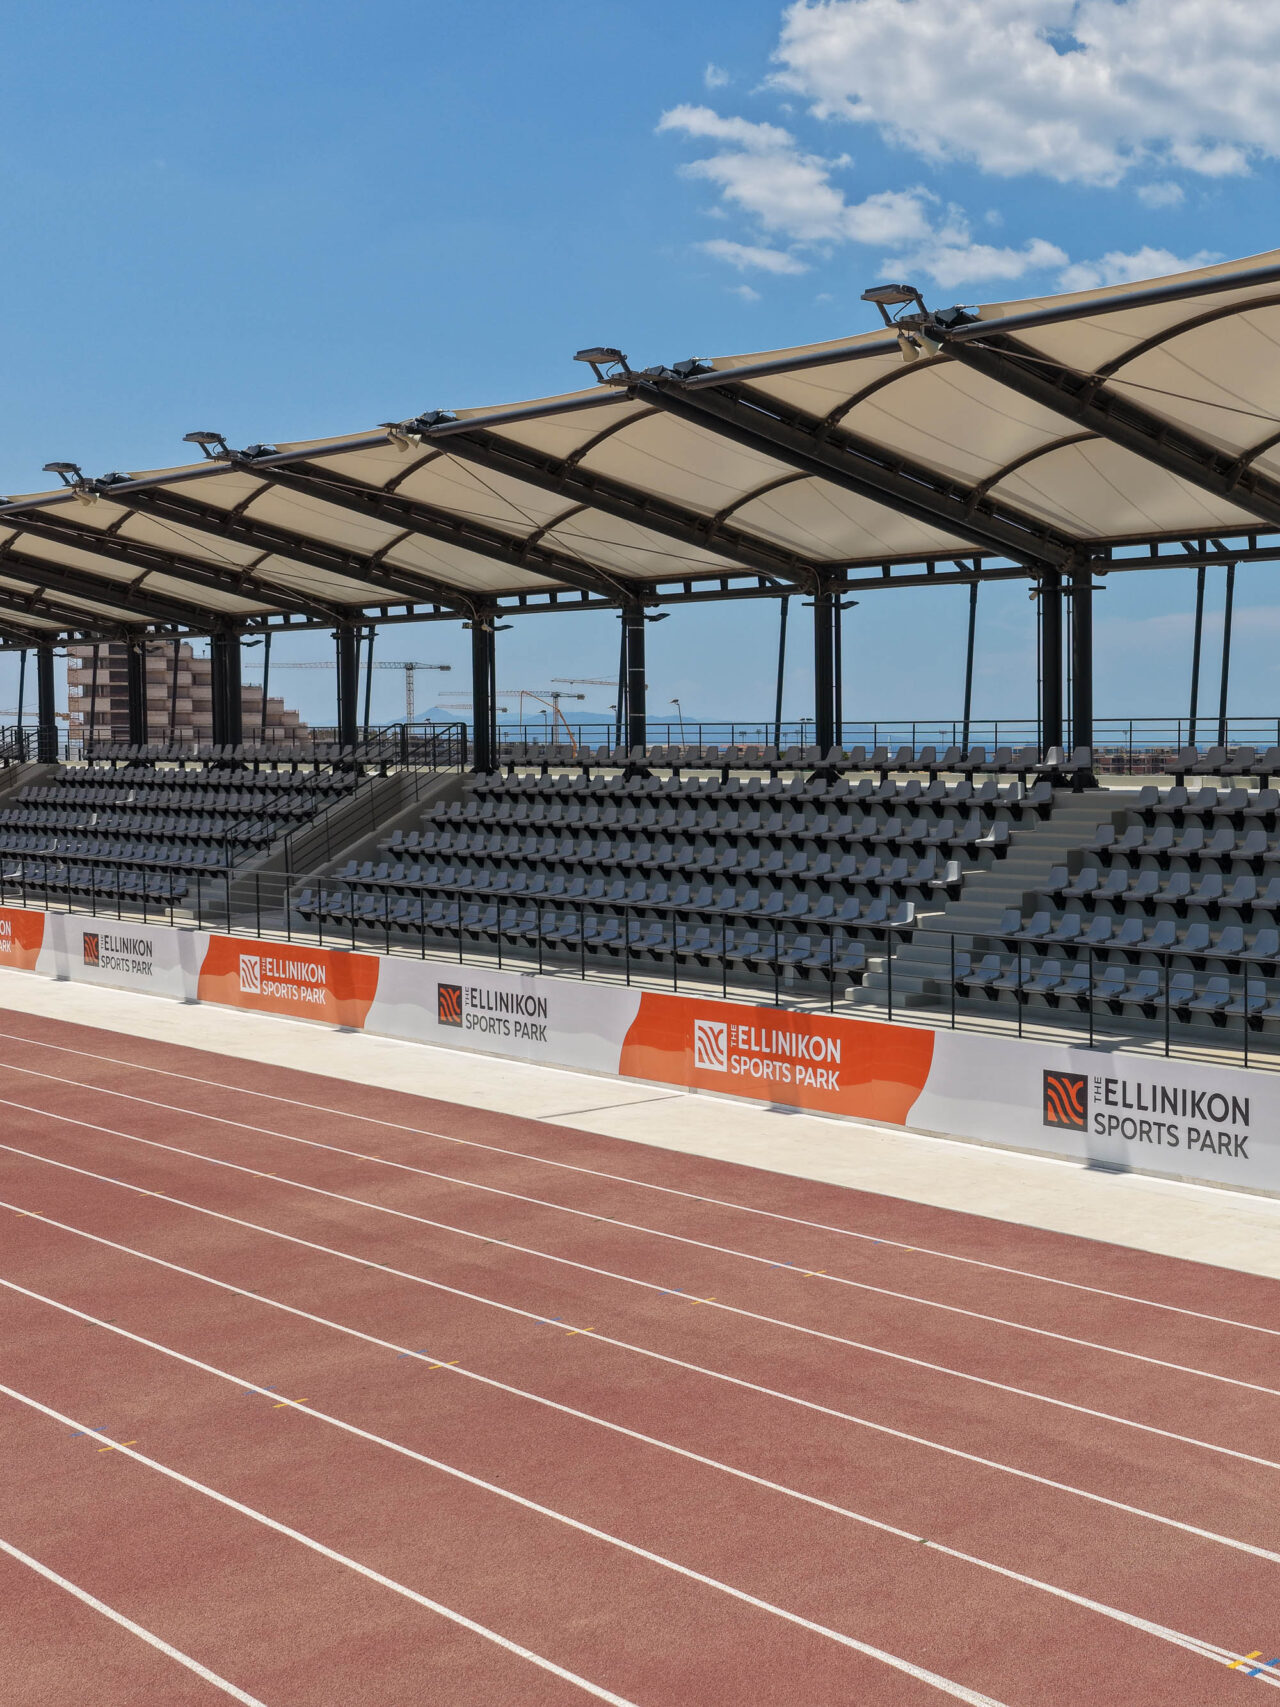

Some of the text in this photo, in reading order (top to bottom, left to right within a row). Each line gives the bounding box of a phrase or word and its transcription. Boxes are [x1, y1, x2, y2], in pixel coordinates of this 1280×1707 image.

[104, 935, 153, 958] ELLINIKON
[101, 954, 153, 976] SPORTS PARK
[266, 957, 326, 985] ELLINIKON
[262, 980, 326, 1005] SPORTS PARK
[470, 987, 548, 1019] ELLINIKON
[465, 1012, 548, 1043] SPORTS PARK
[738, 1024, 841, 1064] ELLINIKON
[730, 1054, 840, 1092] SPORTS PARK
[1093, 1076, 1250, 1127] THE ELLINIKON
[1094, 1112, 1249, 1160] SPORTS PARK
